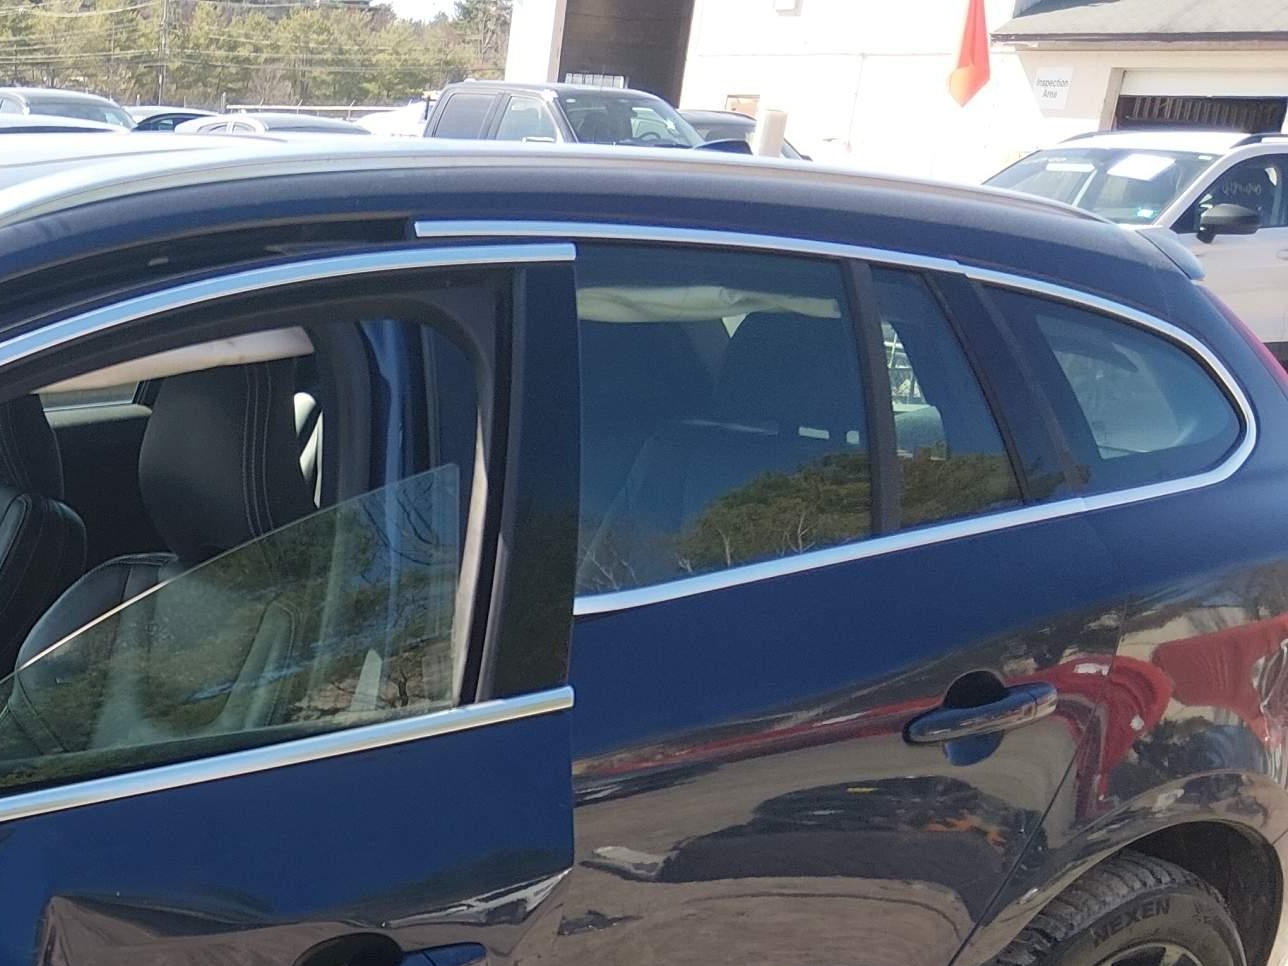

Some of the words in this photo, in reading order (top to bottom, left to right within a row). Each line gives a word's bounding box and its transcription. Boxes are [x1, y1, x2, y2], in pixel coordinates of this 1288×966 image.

[1036, 77, 1069, 88] Inspection
[1041, 88, 1058, 99] Area
[1091, 897, 1171, 948] NEXEN
